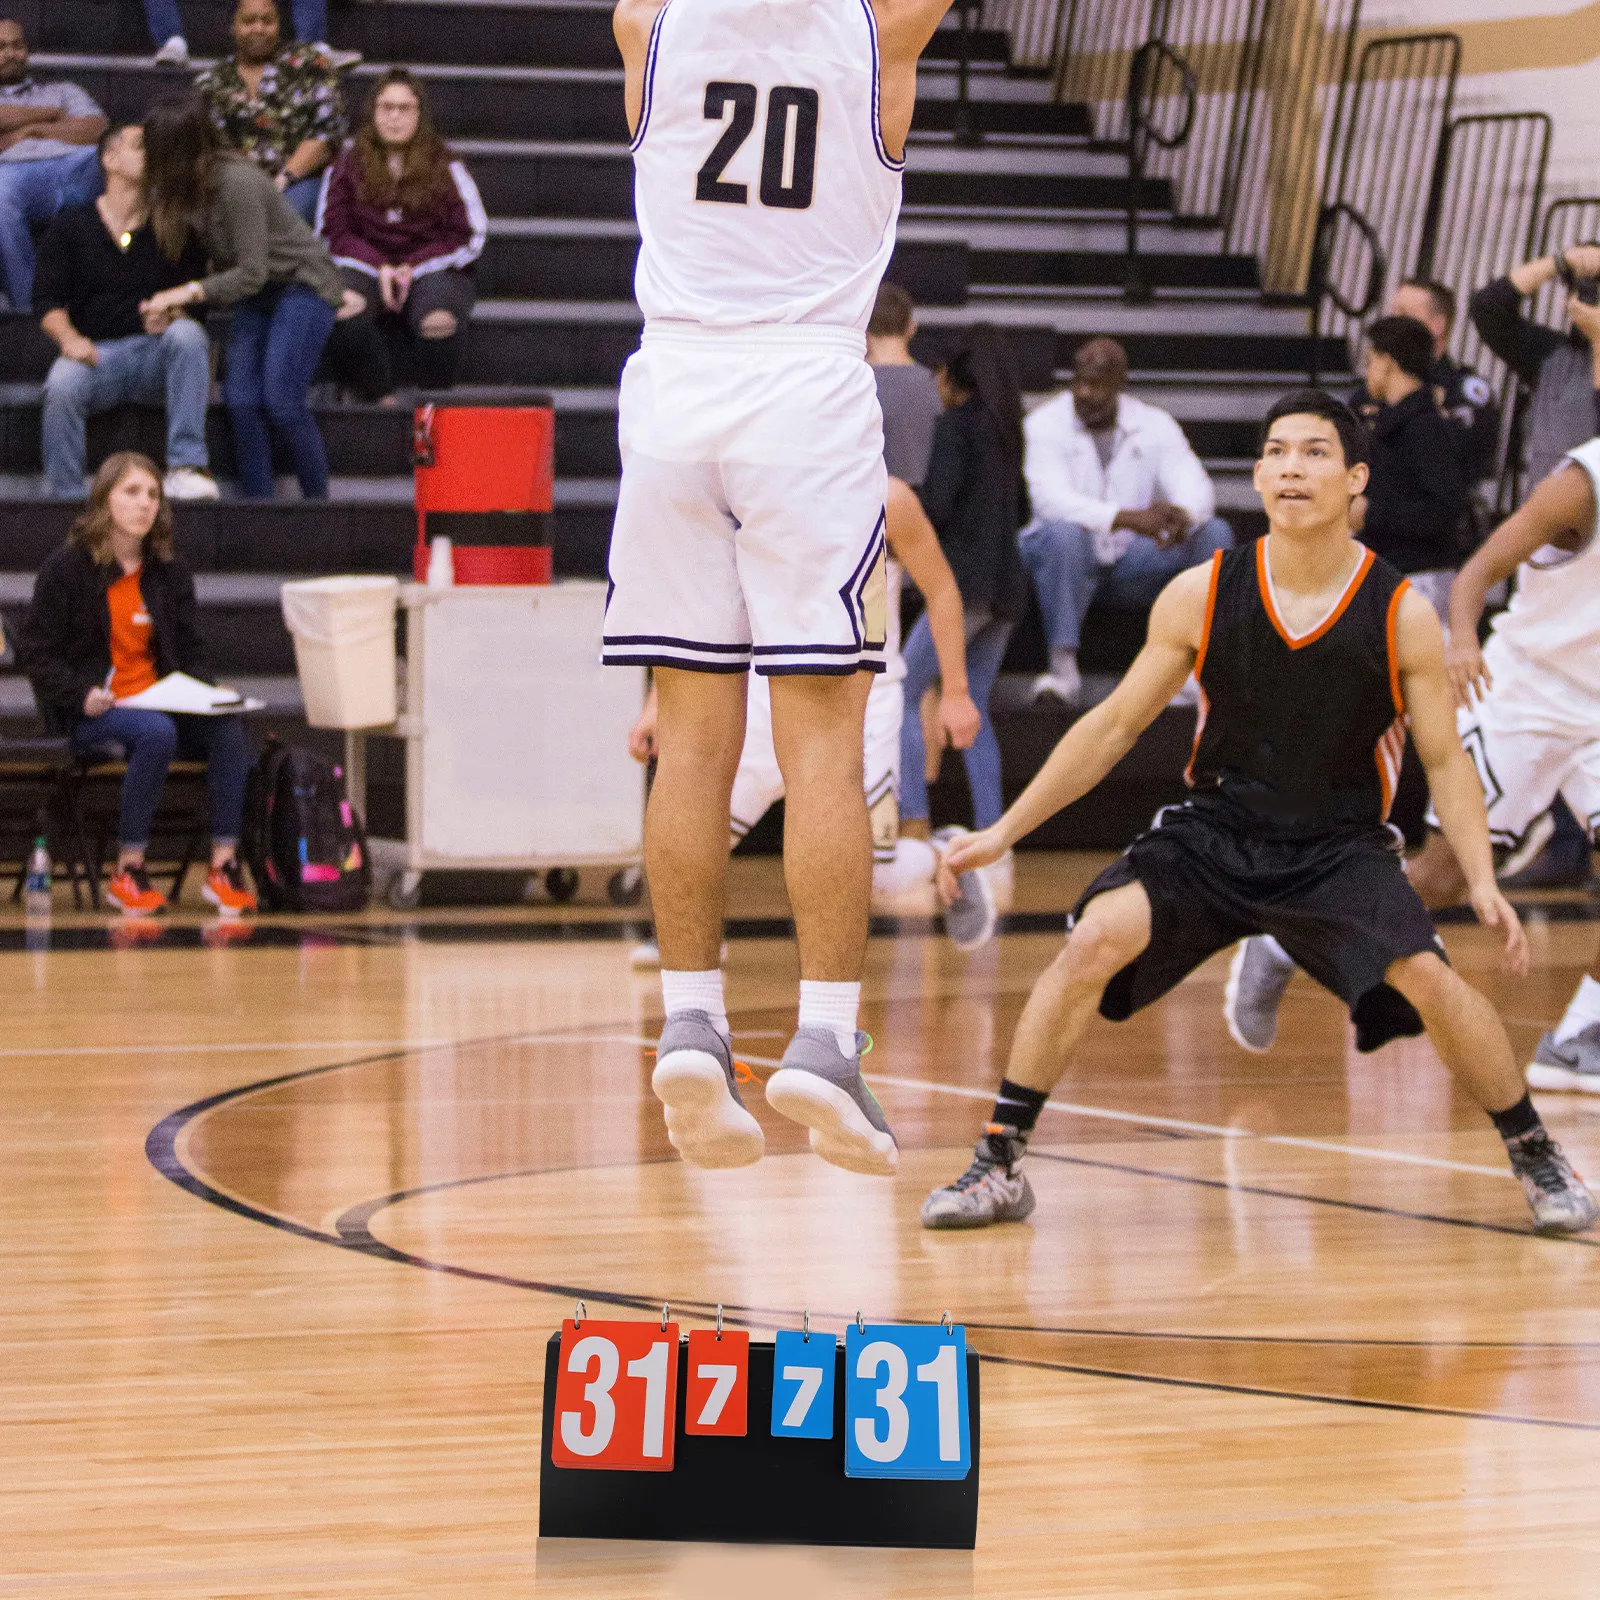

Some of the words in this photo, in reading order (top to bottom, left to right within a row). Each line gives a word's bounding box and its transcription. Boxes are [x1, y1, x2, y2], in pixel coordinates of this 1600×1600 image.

[694, 80, 821, 211] 20
[560, 1336, 670, 1456] 31
[696, 1364, 738, 1425] 7
[781, 1365, 824, 1427] 7
[854, 1340, 961, 1462] 31
